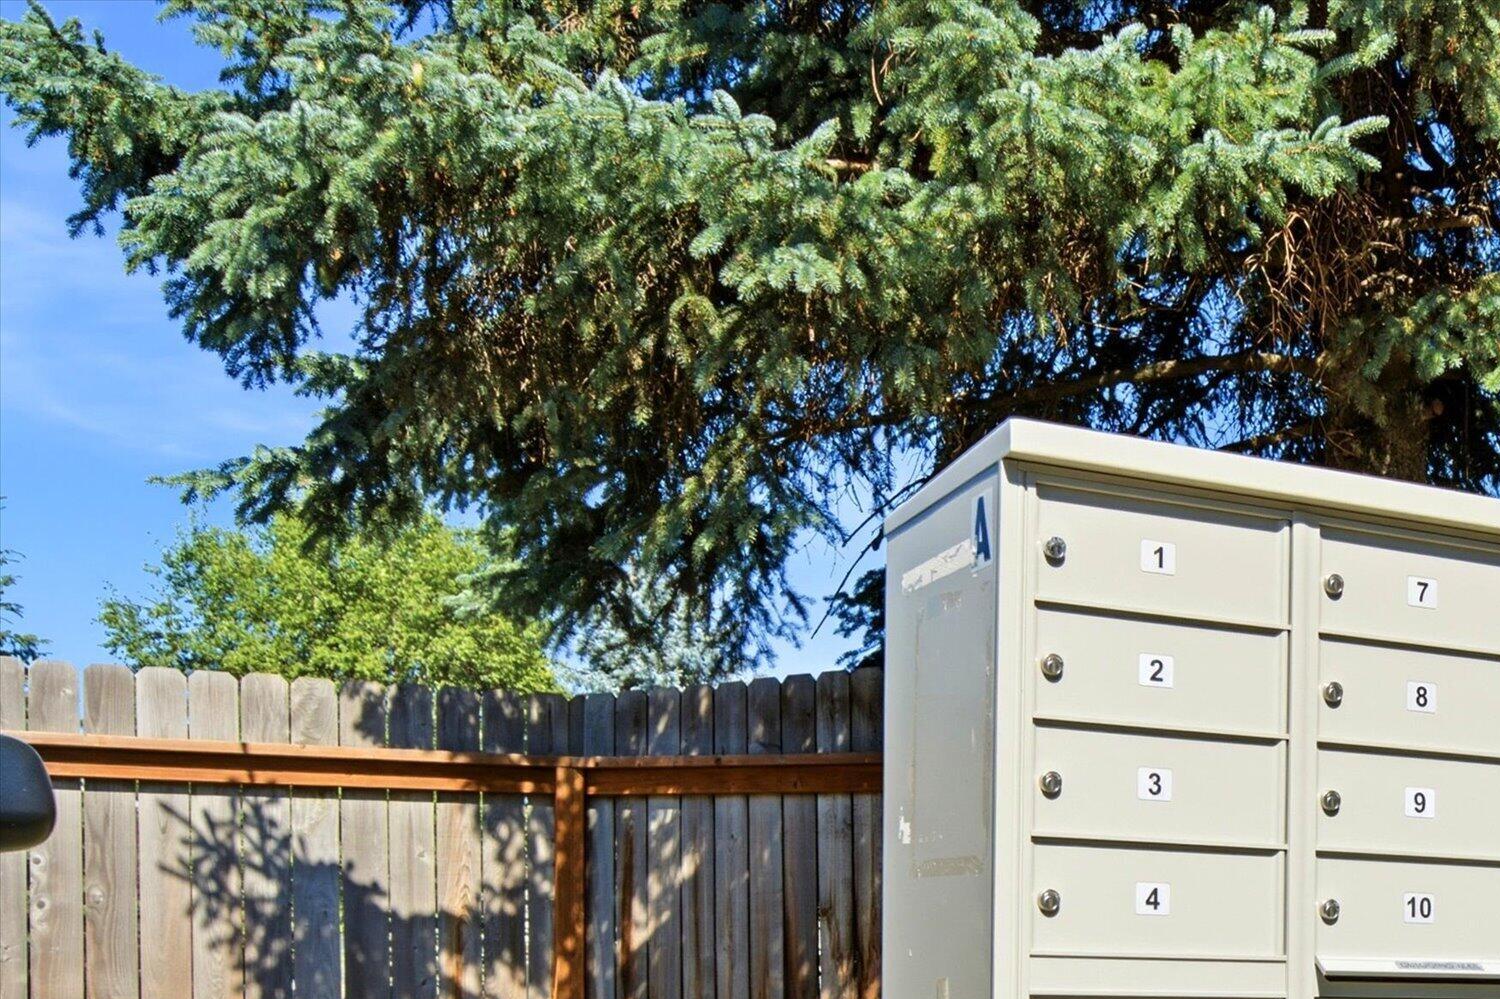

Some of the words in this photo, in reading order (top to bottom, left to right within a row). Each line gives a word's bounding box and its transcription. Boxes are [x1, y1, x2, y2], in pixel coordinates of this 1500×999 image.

[972, 497, 990, 567] A
[1153, 546, 1164, 569] 1
[1416, 581, 1429, 603] 7
[1149, 659, 1164, 682] 2
[1415, 686, 1428, 708] 8
[1148, 772, 1162, 796] 3
[1413, 792, 1426, 814] 9
[1145, 887, 1161, 911] 4
[1407, 896, 1432, 919] 10
